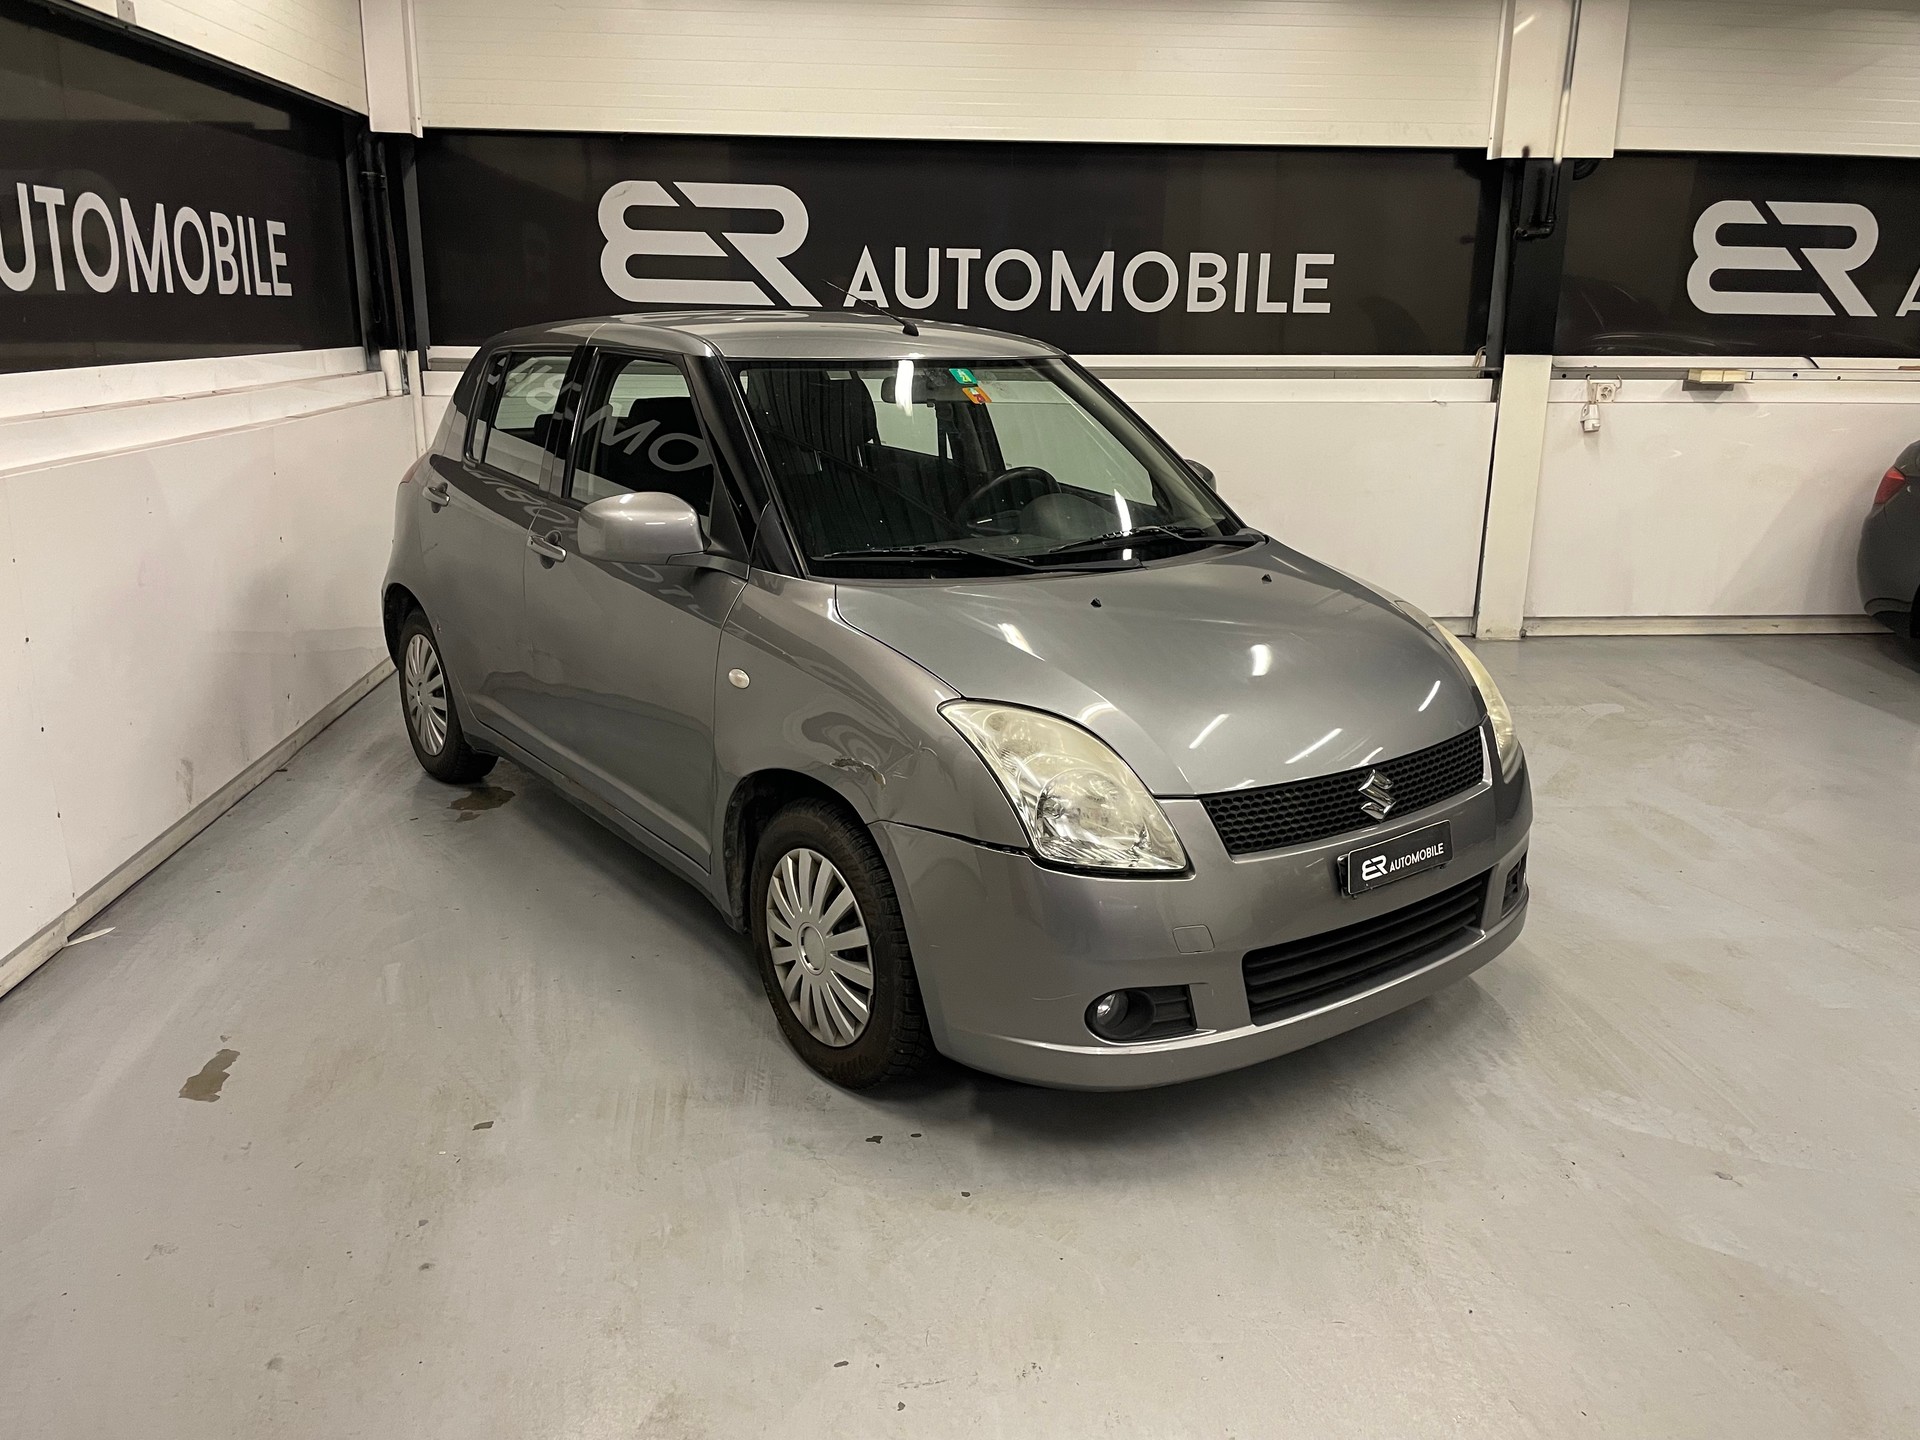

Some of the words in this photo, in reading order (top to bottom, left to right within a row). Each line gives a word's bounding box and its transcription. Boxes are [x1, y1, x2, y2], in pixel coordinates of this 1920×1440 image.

[598, 180, 823, 307] ER
[843, 244, 1335, 314] AUTOMOBILE
[1686, 199, 1879, 317] ER
[1361, 854, 1389, 881] ER
[1390, 842, 1444, 873] AUTOMOBILE
